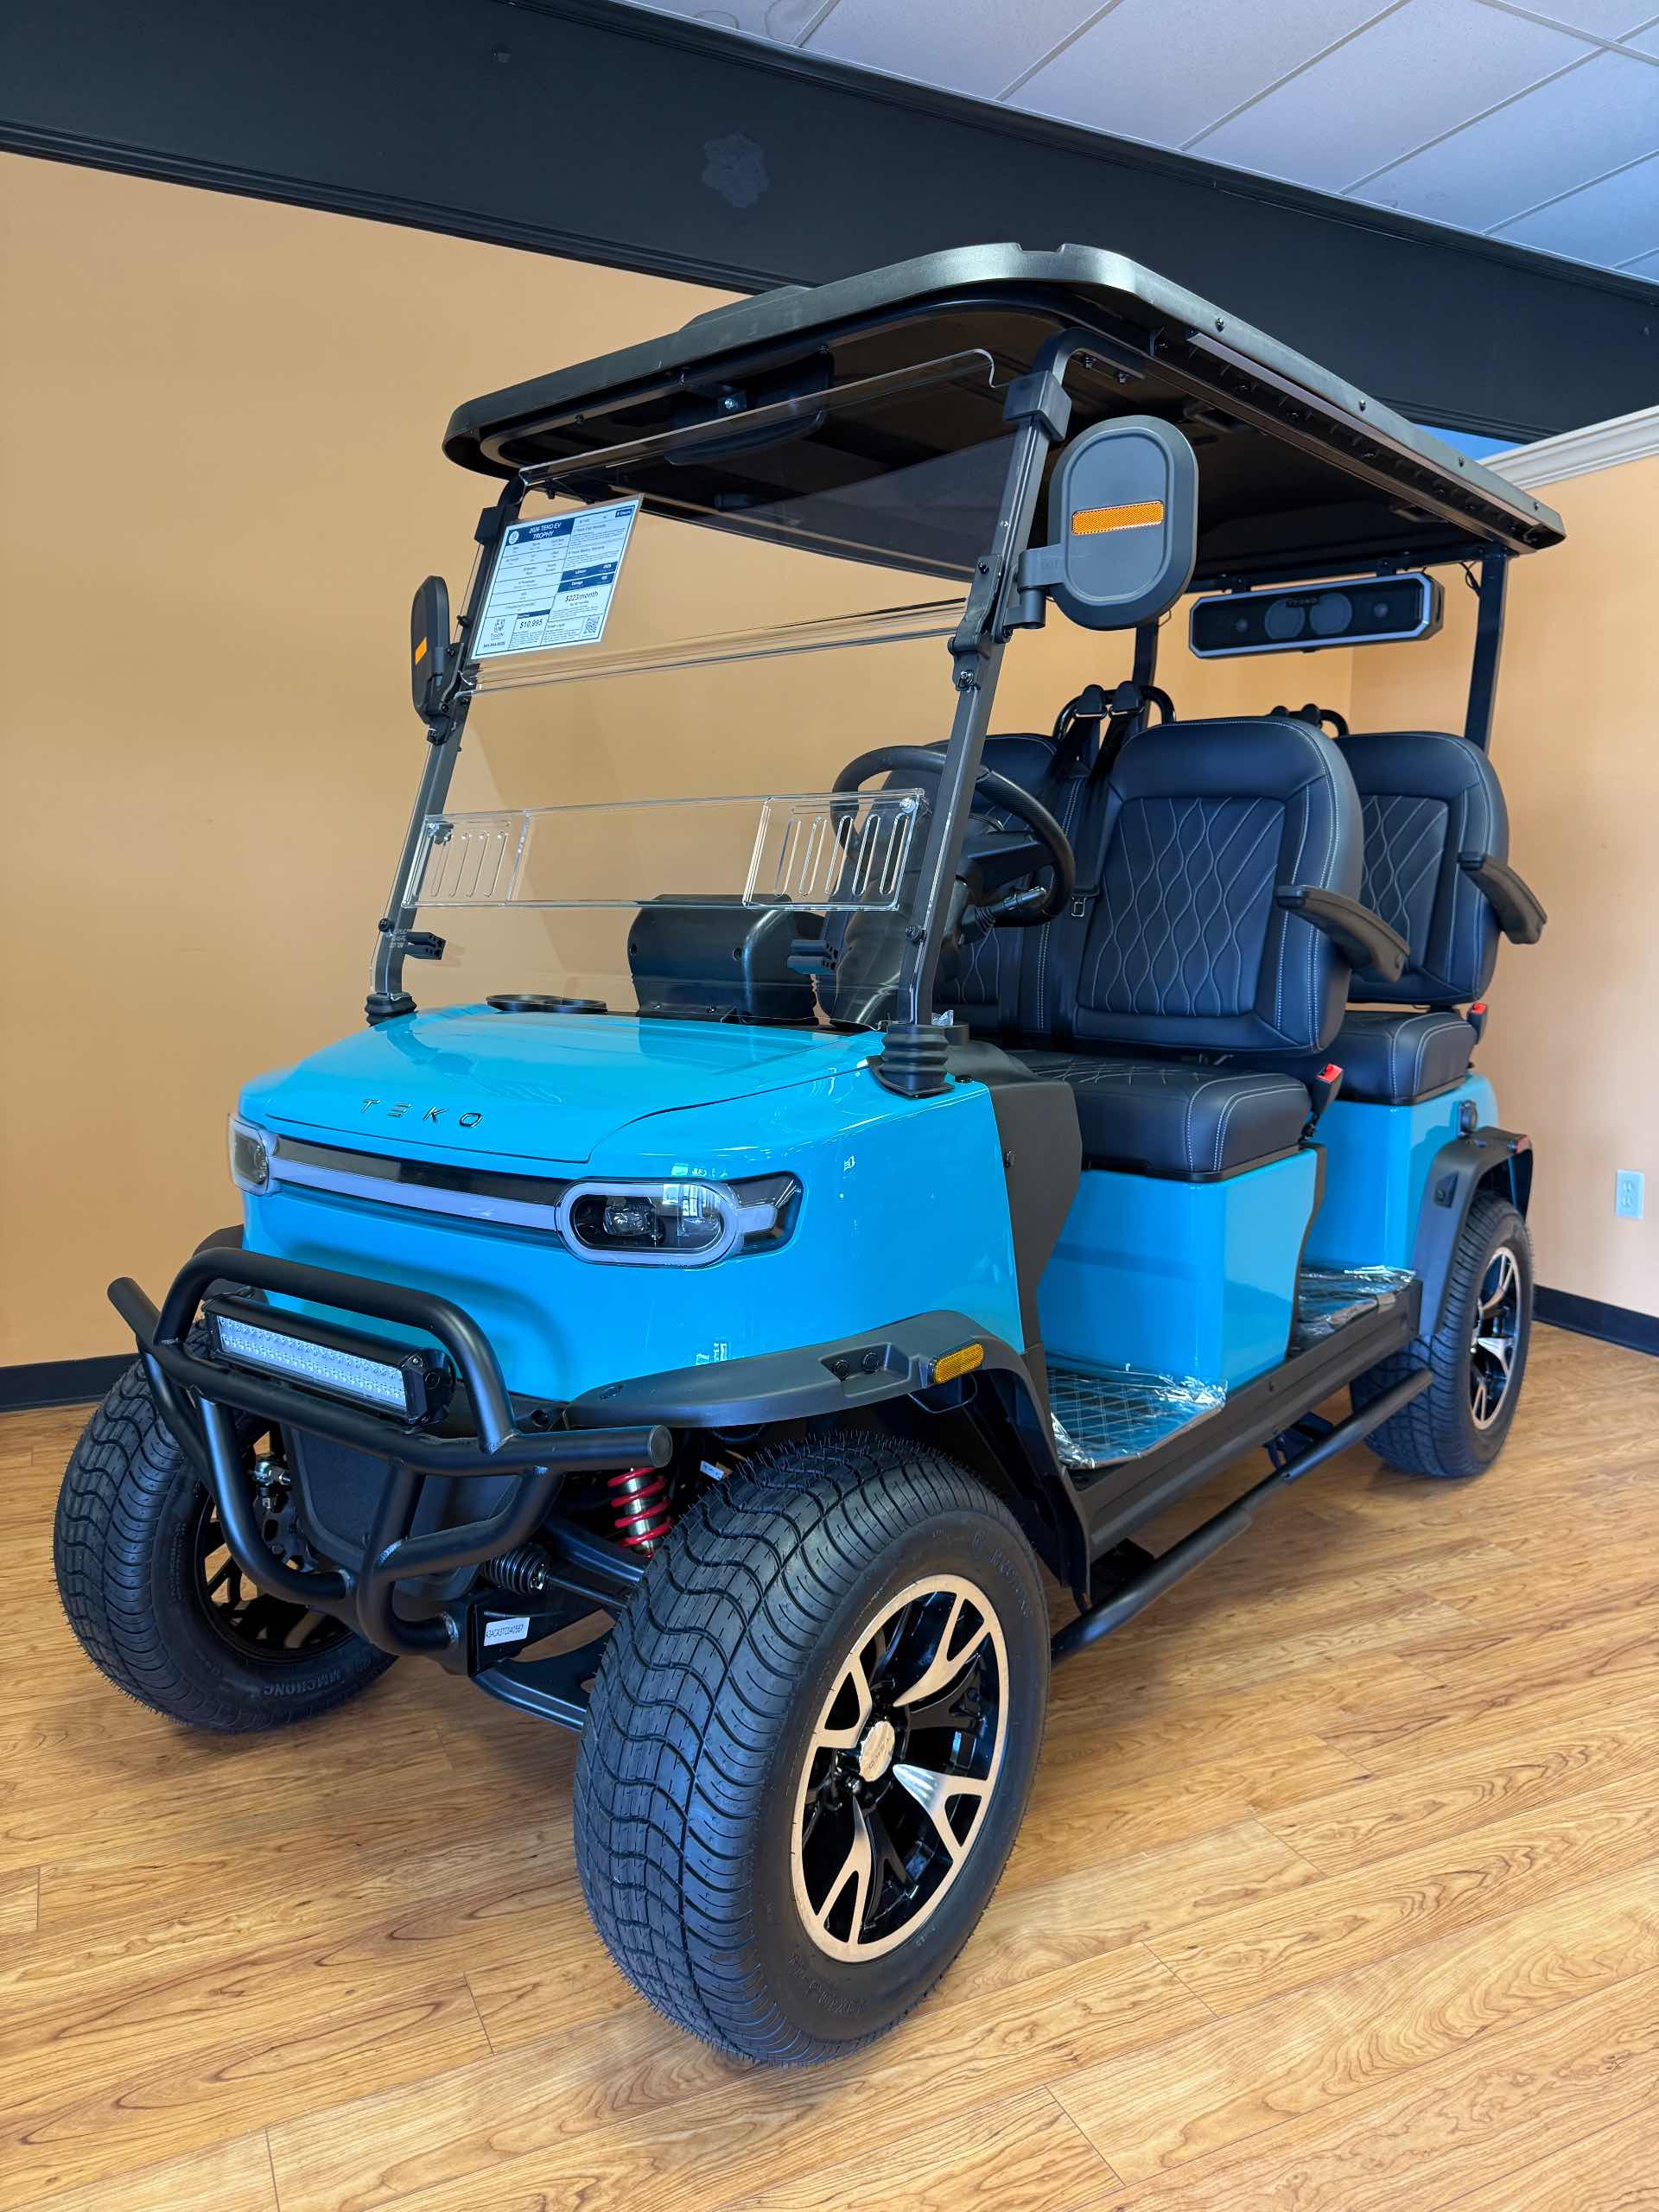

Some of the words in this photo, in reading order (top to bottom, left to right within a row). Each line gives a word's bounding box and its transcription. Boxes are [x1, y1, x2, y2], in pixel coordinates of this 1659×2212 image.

[532, 530, 555, 539] TROPHY
[565, 590, 599, 602] $223/month
[519, 618, 543, 629] $10,995
[361, 1098, 483, 1128] TEKO
